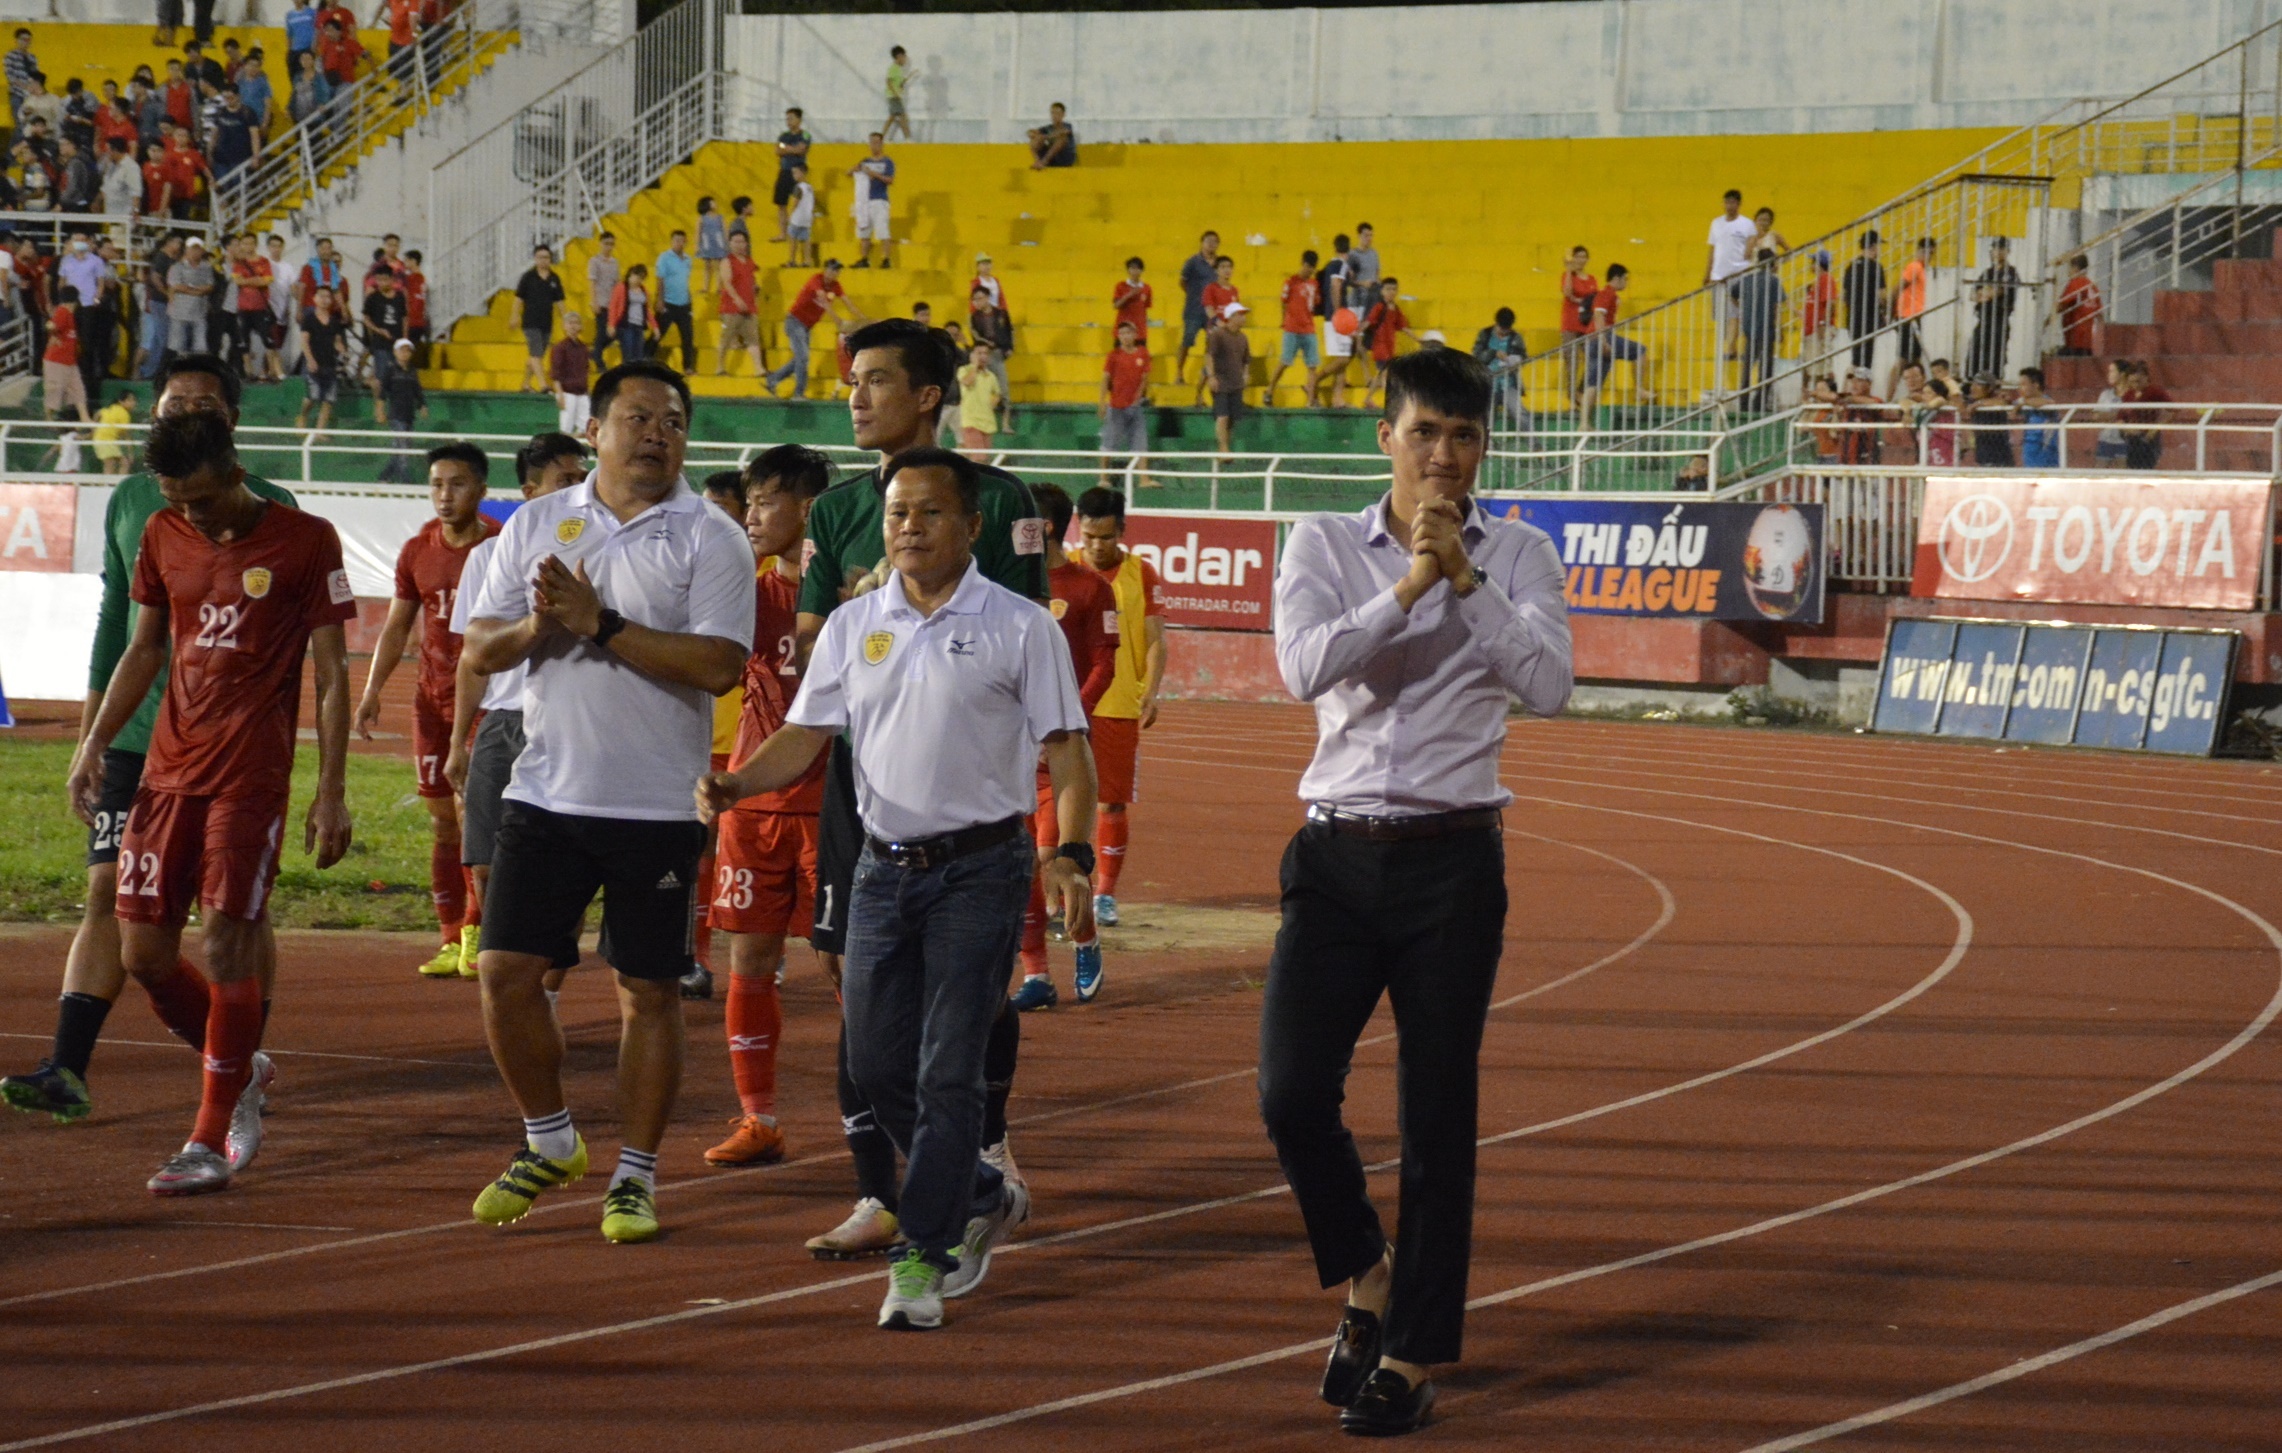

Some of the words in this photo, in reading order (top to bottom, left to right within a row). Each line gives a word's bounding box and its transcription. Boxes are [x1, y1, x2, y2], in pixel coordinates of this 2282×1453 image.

[0, 506, 48, 559] A
[1562, 522, 1622, 566] THI
[1625, 503, 1709, 568] ĐẤU
[2026, 505, 2235, 578] TOYOTA
[194, 603, 239, 649] 22
[415, 755, 438, 786] 17
[93, 811, 129, 851] 25
[117, 849, 160, 897] 22
[713, 865, 755, 910] 23
[814, 884, 835, 931] 1
